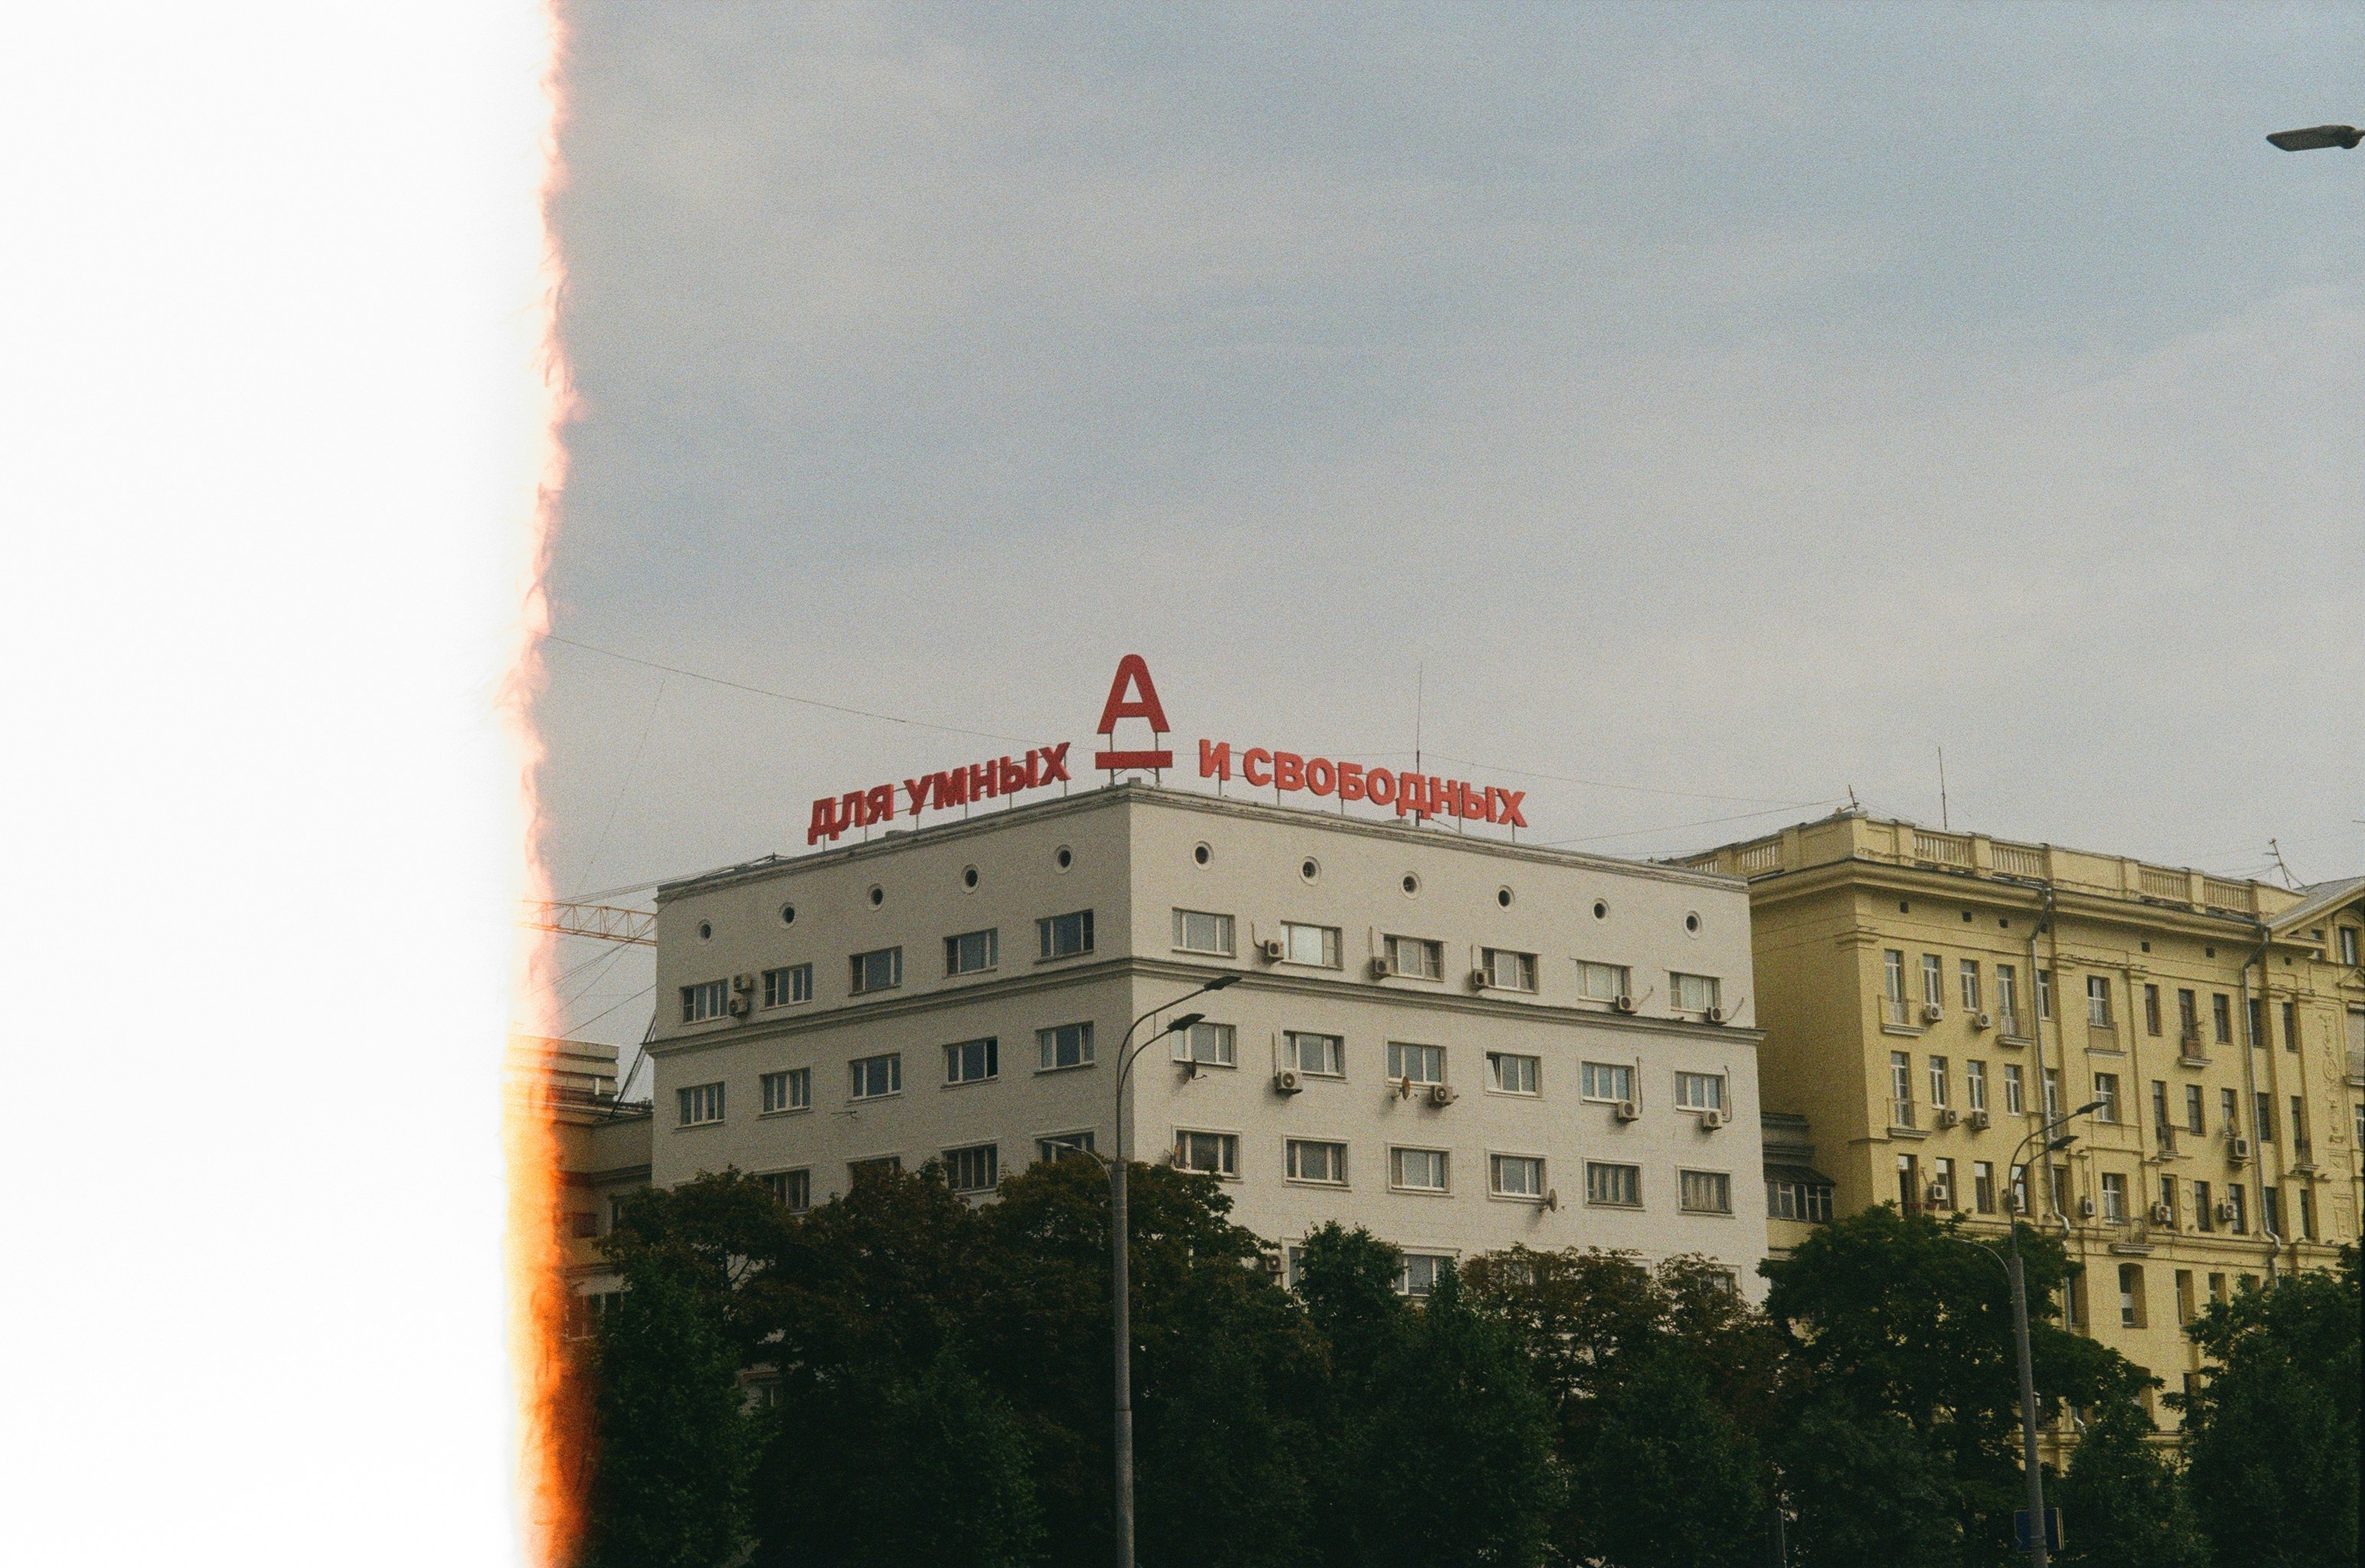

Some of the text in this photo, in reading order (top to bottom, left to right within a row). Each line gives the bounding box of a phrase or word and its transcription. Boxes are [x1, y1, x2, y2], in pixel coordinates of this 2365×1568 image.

[1096, 654, 1171, 734] А
[808, 742, 1071, 845] ДЛЯ УМНЫХ
[1199, 739, 1528, 828] И СВОБОДНЫХ
